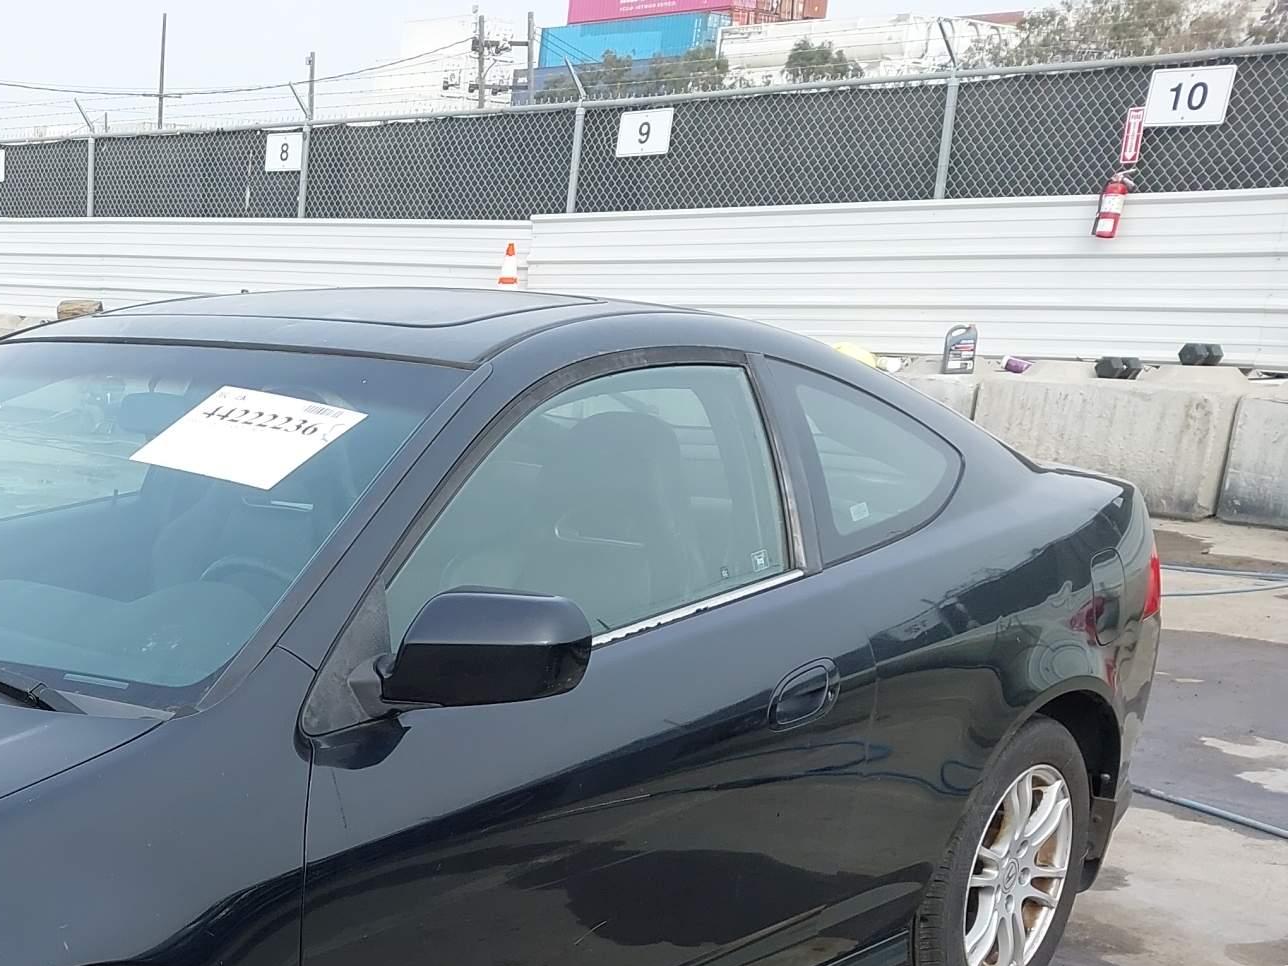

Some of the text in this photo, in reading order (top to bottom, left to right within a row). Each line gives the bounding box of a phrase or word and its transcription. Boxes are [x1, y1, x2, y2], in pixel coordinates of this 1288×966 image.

[1169, 81, 1209, 111] 10
[637, 121, 651, 145] 9
[279, 142, 289, 162] 8
[202, 405, 319, 436] 44222236
